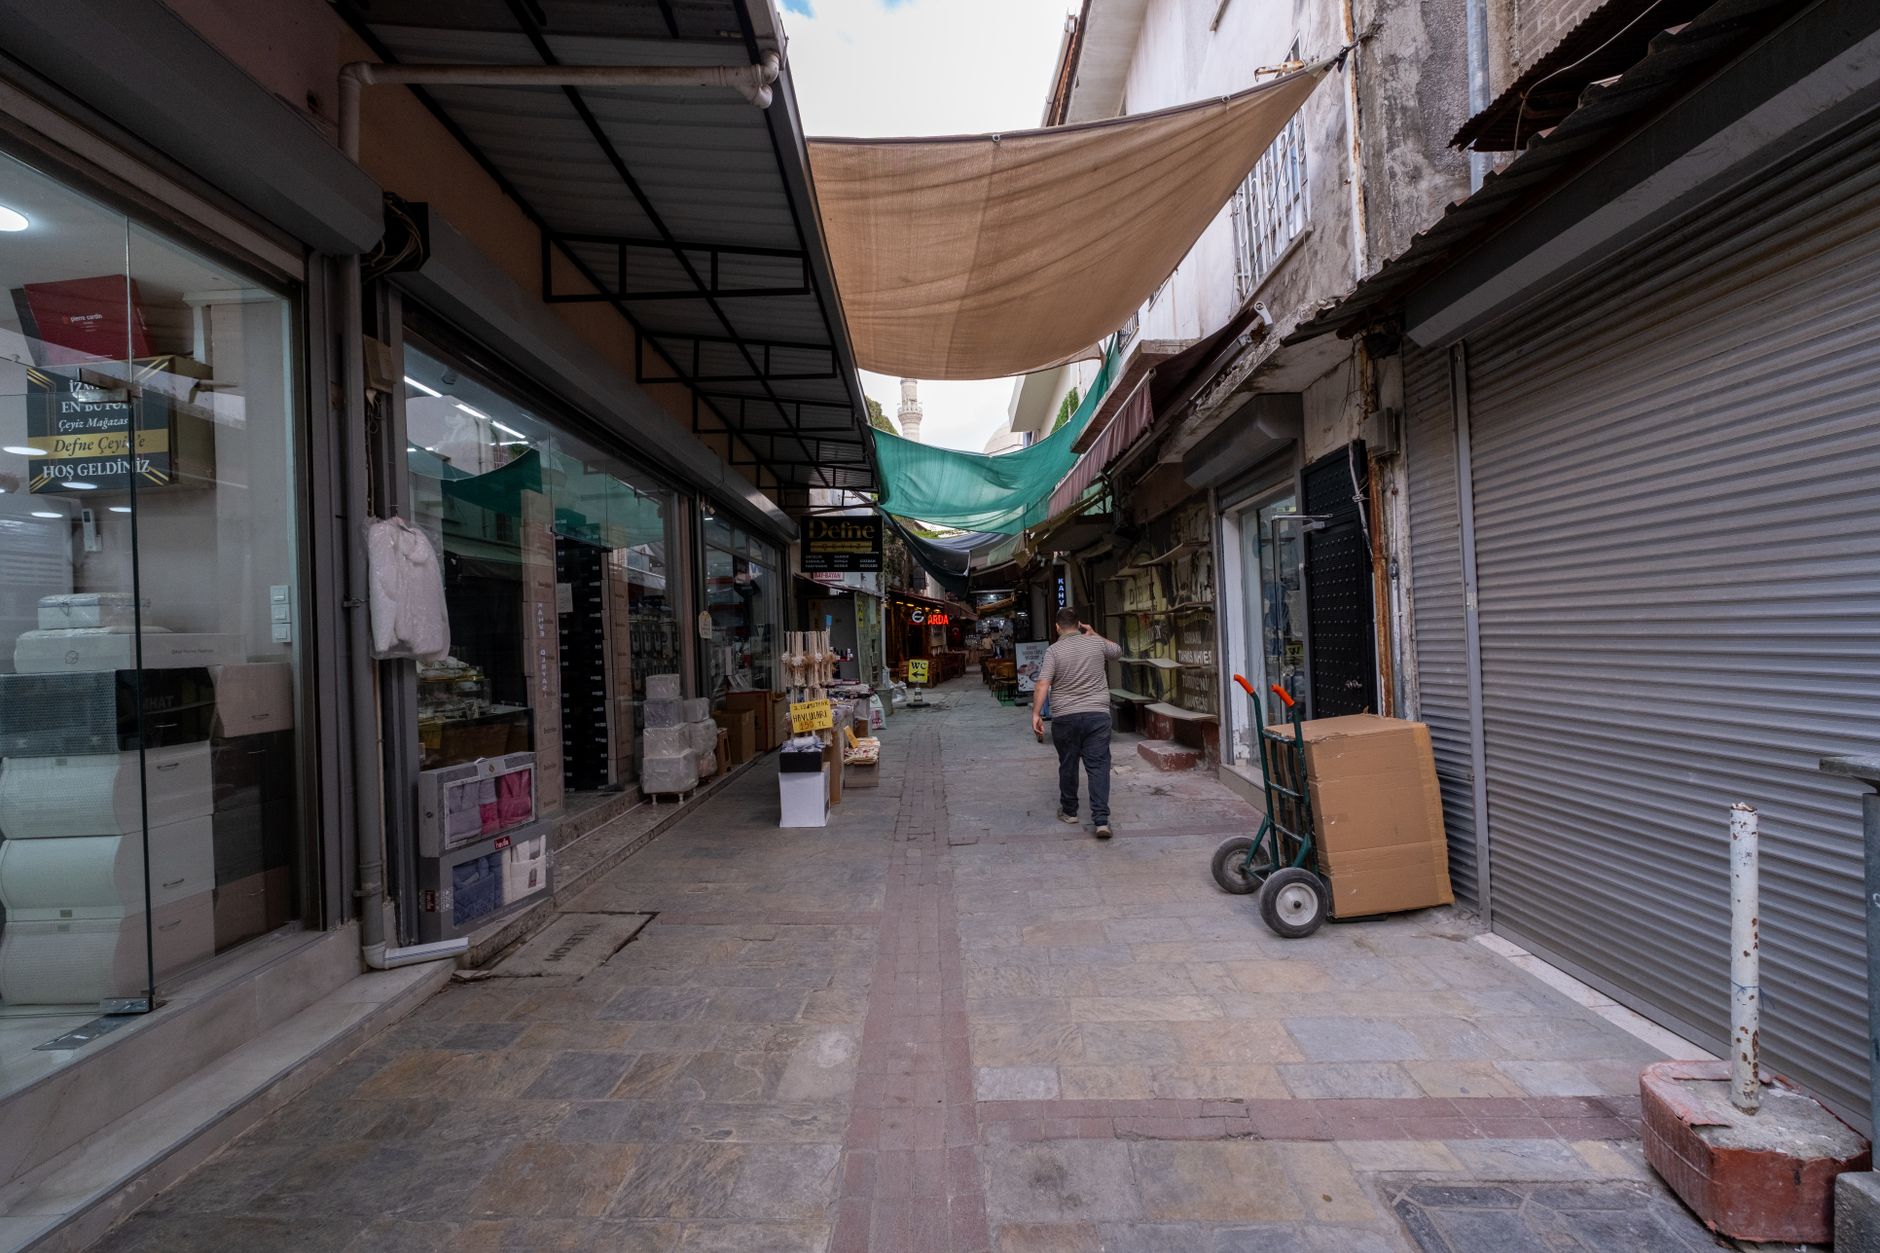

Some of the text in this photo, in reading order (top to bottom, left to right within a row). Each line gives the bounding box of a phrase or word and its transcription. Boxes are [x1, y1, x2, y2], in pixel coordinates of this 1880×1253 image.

[62, 401, 81, 413] EN
[58, 417, 129, 433] Çeyiz Mağazas
[53, 434, 146, 457] Defne Çeyi'e
[43, 464, 75, 482] HOŞ
[808, 518, 876, 539] Defne
[927, 614, 949, 625] ARDA
[911, 661, 927, 670] WC
[793, 710, 827, 723] HAVLULARI
[817, 720, 826, 728] TL
